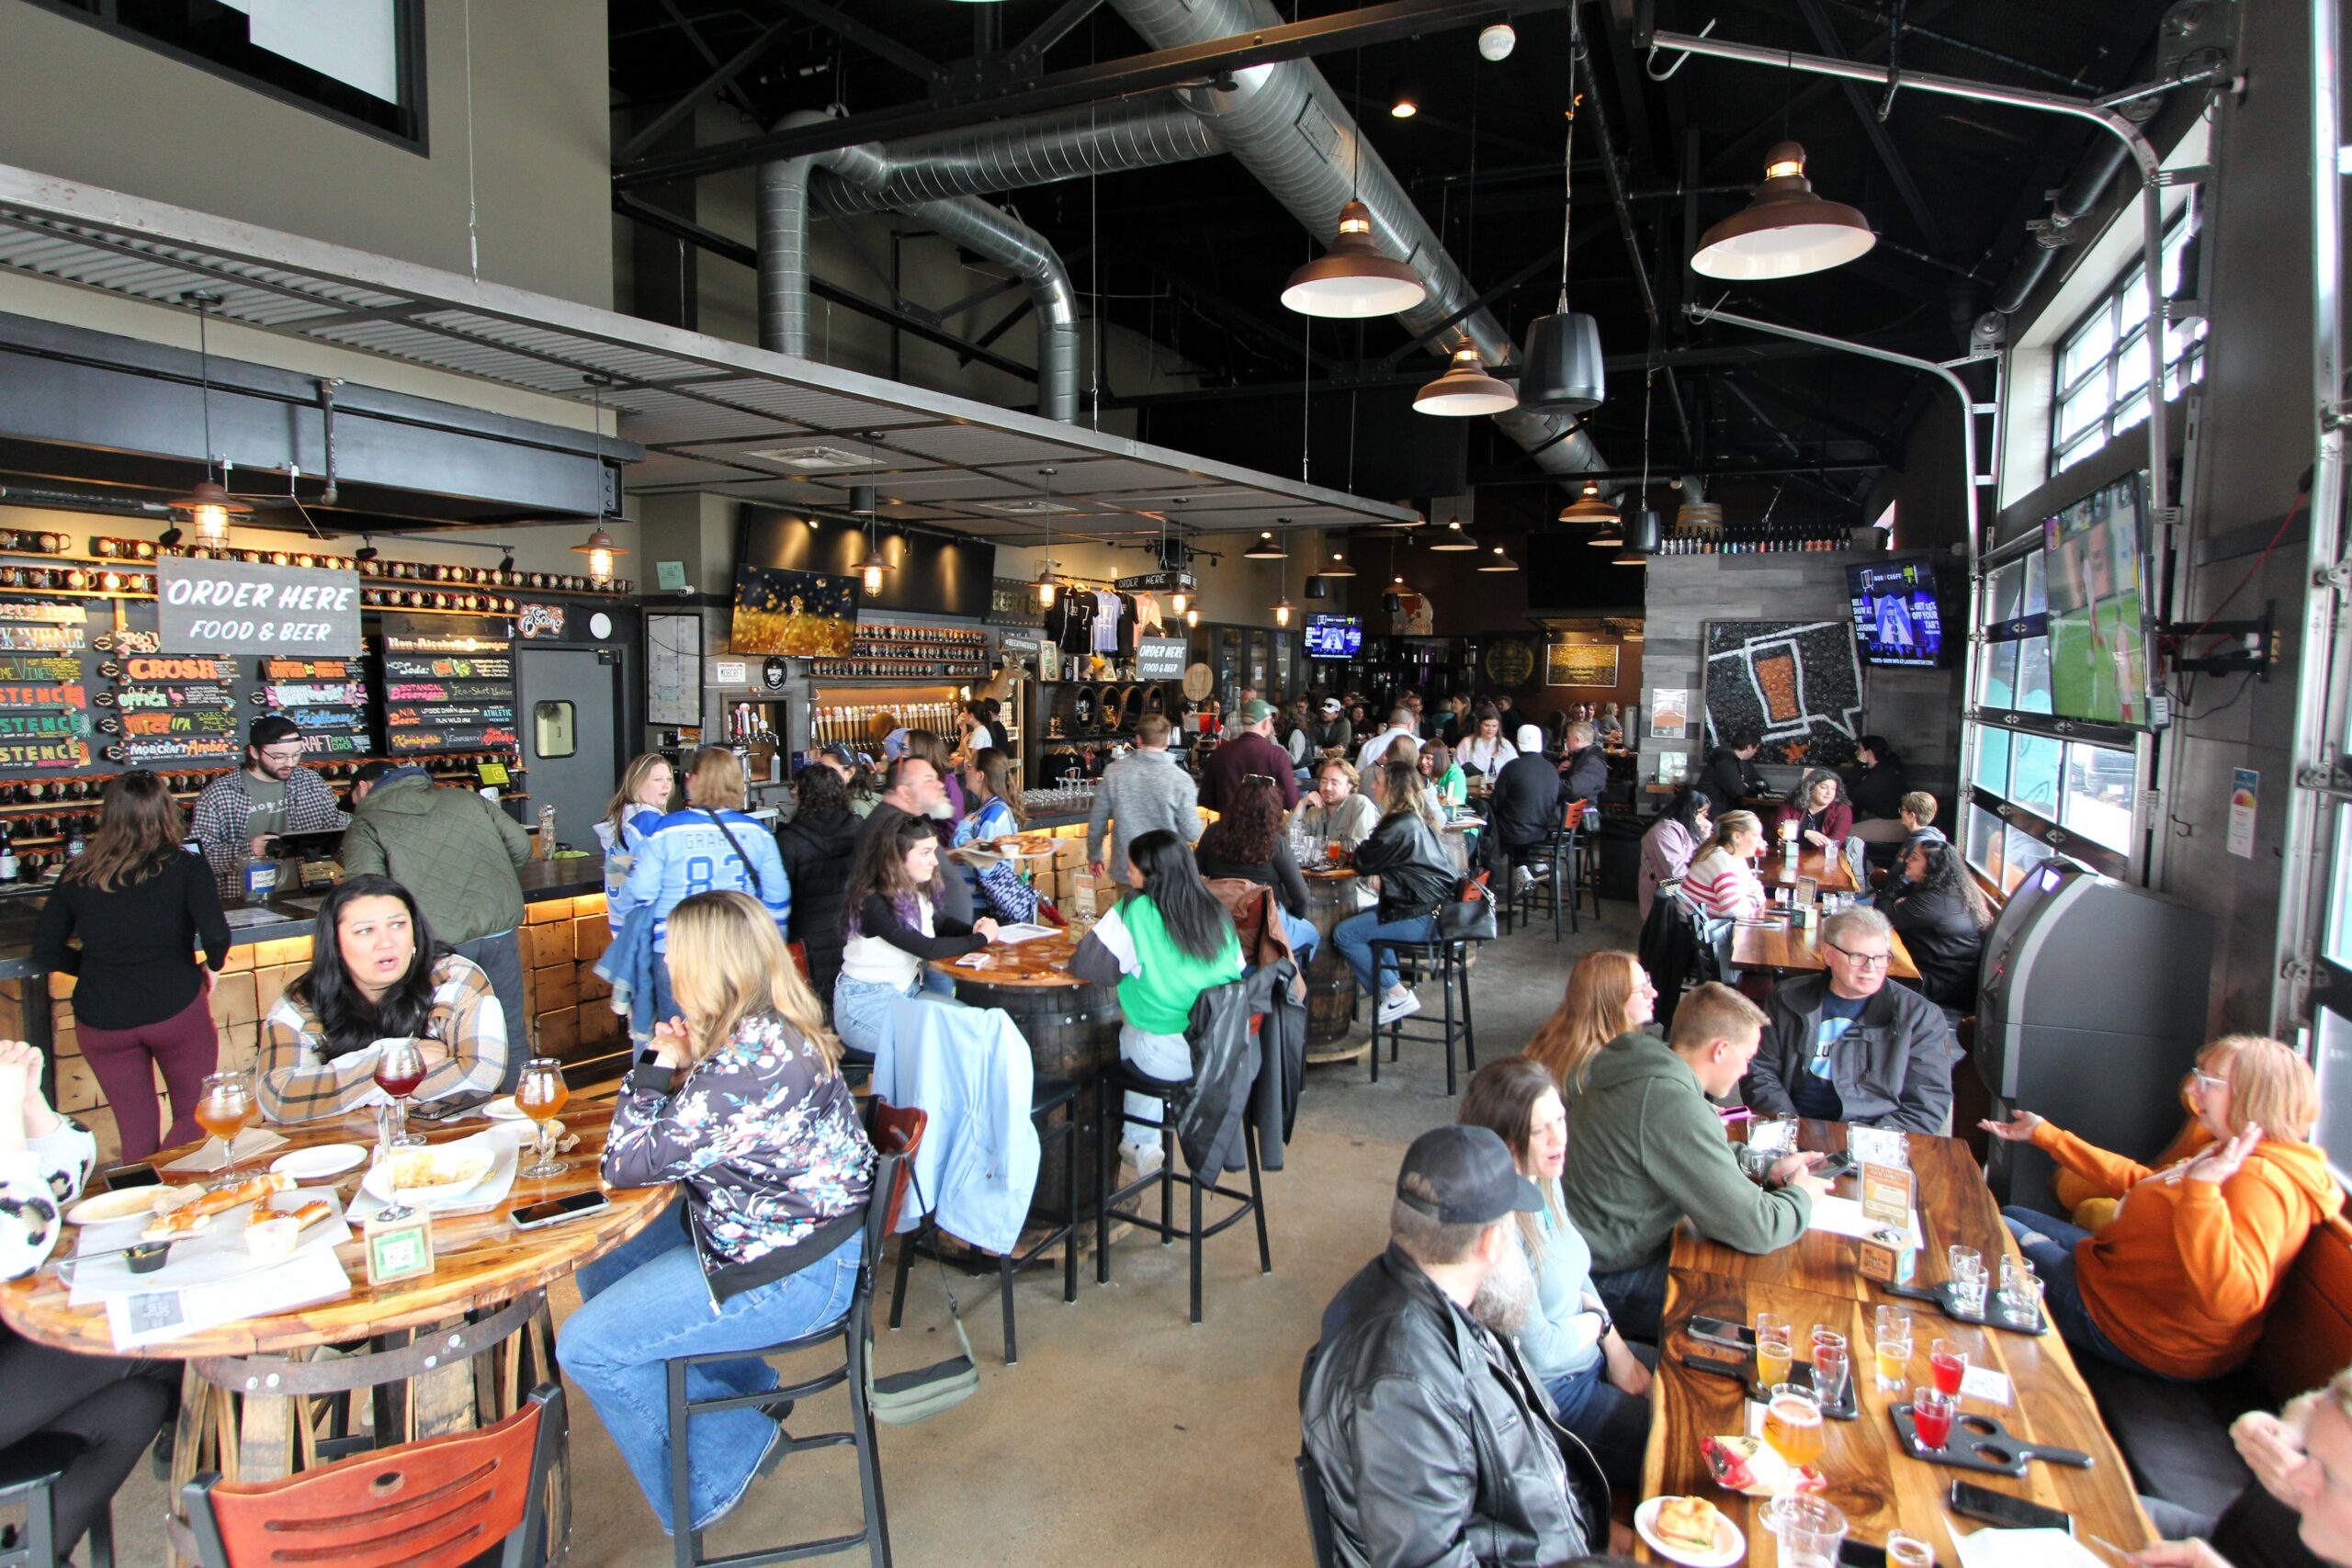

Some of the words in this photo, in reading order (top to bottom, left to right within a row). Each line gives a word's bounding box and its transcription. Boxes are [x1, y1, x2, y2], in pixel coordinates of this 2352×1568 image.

[1118, 578, 1138, 588] ORDER
[1145, 573, 1167, 585] HERE
[167, 579, 275, 608] ORDER
[278, 585, 355, 612] HERE
[1912, 612, 1922, 620] OFF
[1922, 611, 1939, 619] YOUR
[189, 620, 254, 639] FOOD
[258, 622, 275, 642] &
[279, 622, 332, 642] BEER
[1139, 645, 1164, 659] ORDER
[1165, 646, 1185, 659] HERE
[127, 659, 219, 680] CRUSH
[386, 661, 405, 670] HOP
[400, 662, 430, 675] Soda:
[1143, 662, 1159, 672] FOOD
[1163, 663, 1179, 673] BEER
[390, 687, 446, 701] Beverages
[400, 683, 445, 692] BOTANICAL
[118, 694, 168, 707] OFFICE
[398, 707, 416, 716] N/A
[483, 708, 513, 717] ATHLETIC
[171, 717, 192, 732] IPA
[202, 724, 227, 732] ALE
[332, 736, 351, 744] APPLE
[332, 742, 353, 751] CIDER
[130, 743, 187, 756] MOBCRAFT
[186, 739, 230, 756] Amber
[248, 801, 273, 814] MOB
[685, 832, 748, 850] GRAHM
